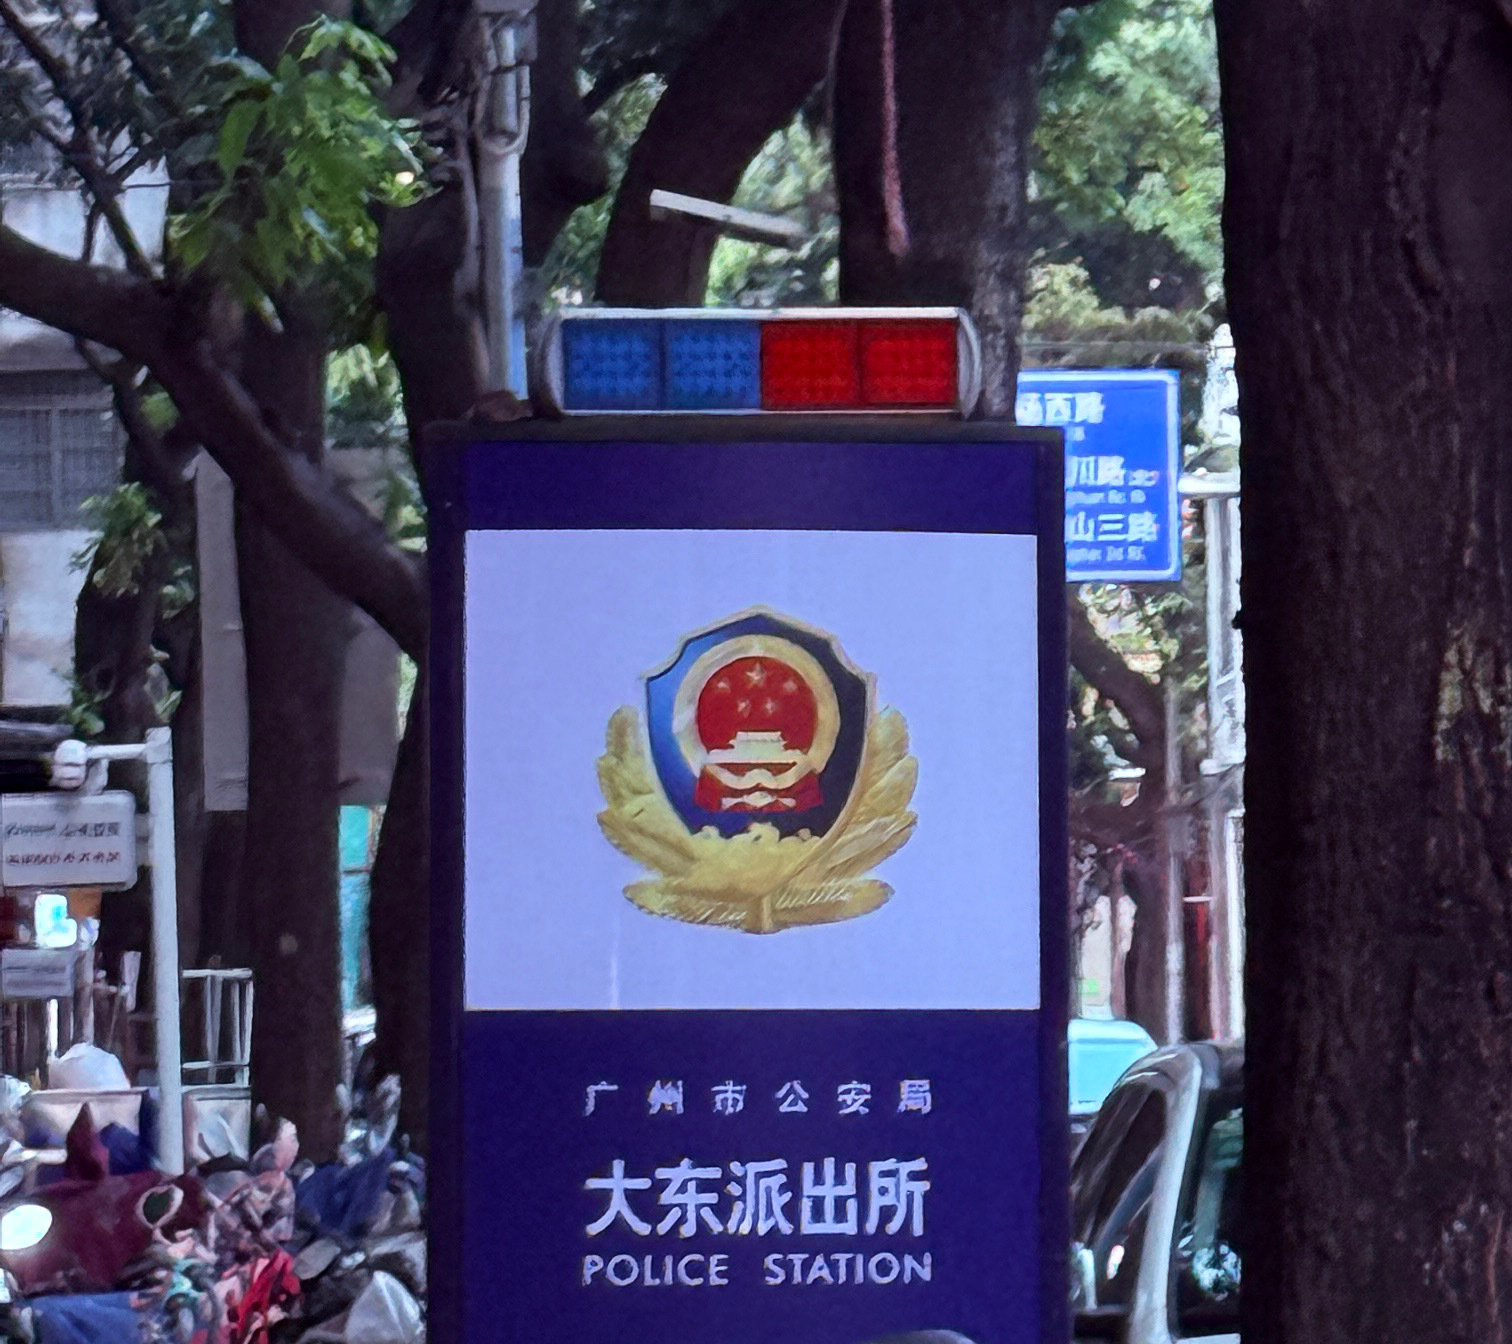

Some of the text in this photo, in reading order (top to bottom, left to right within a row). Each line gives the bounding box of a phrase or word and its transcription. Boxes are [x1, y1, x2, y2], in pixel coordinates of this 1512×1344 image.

[585, 1079, 933, 1116] 广州市公安局
[584, 1156, 932, 1238] 大东派出所
[582, 1251, 933, 1287] POLICE STATION
